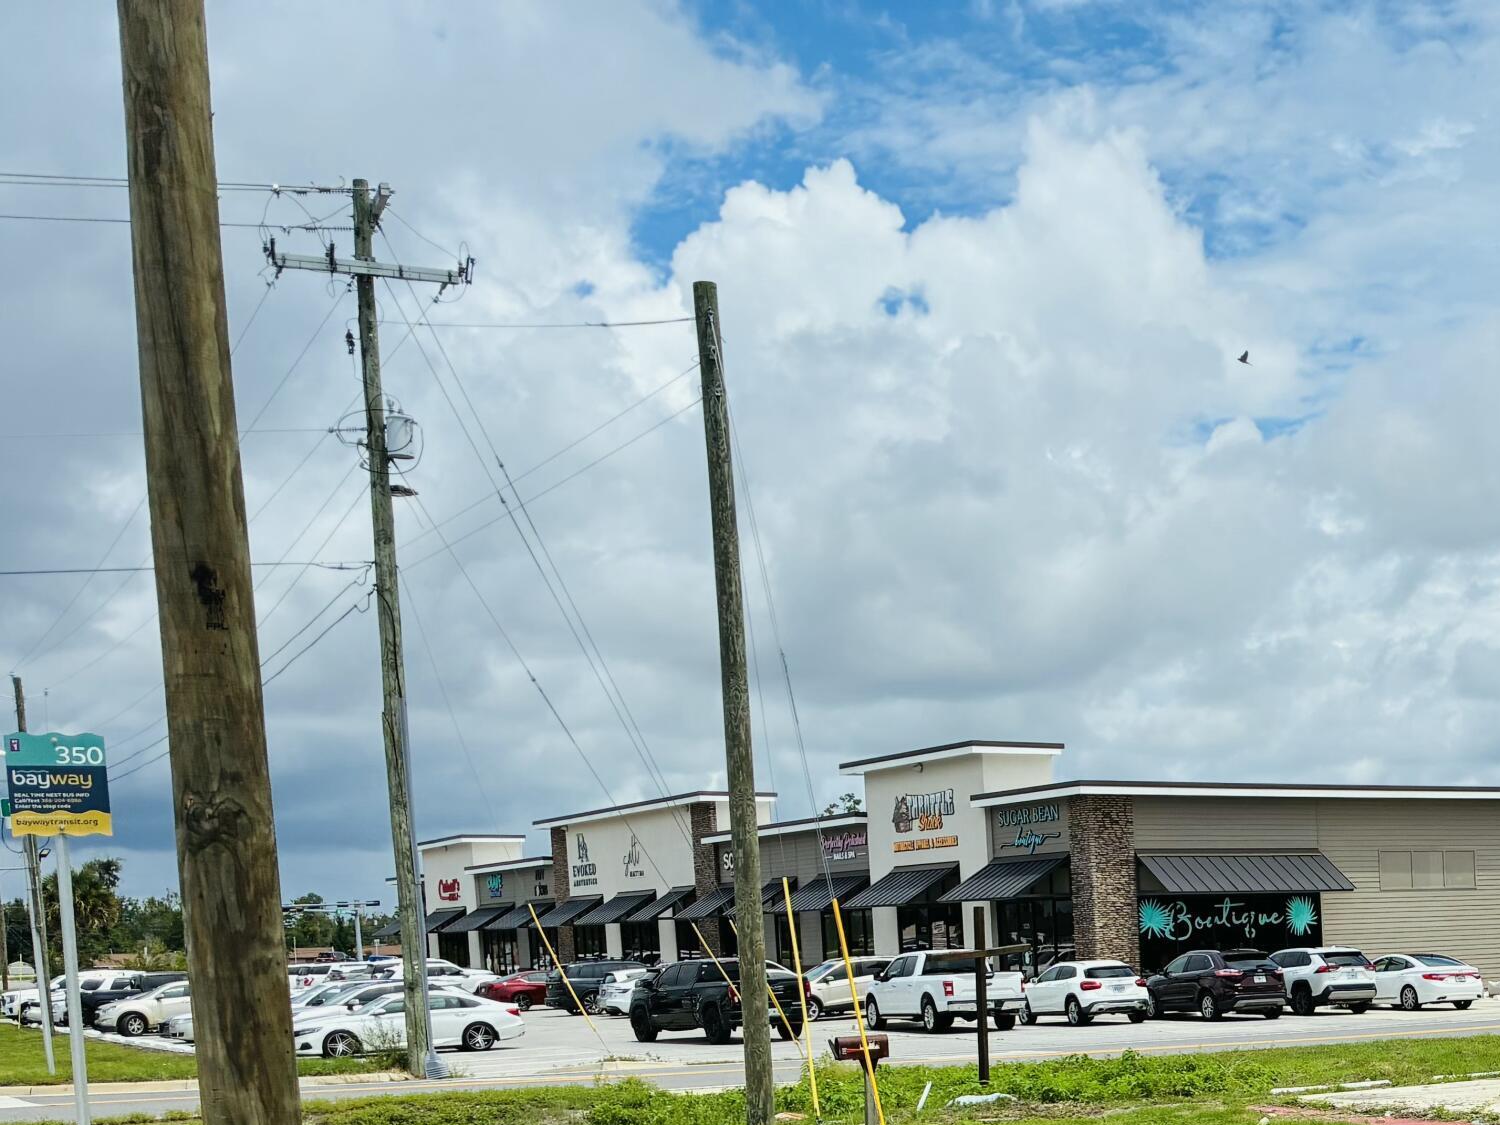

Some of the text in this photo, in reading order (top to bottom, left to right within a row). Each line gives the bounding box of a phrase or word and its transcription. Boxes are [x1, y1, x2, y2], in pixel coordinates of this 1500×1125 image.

[55, 746, 103, 764] 350
[12, 770, 92, 789] bayway
[905, 789, 955, 821] THROTTLE
[999, 803, 1060, 827] SUGAR BEAN
[1000, 827, 1061, 855] boutique
[573, 863, 597, 878] EVOKED
[1165, 897, 1284, 941] Boutique
